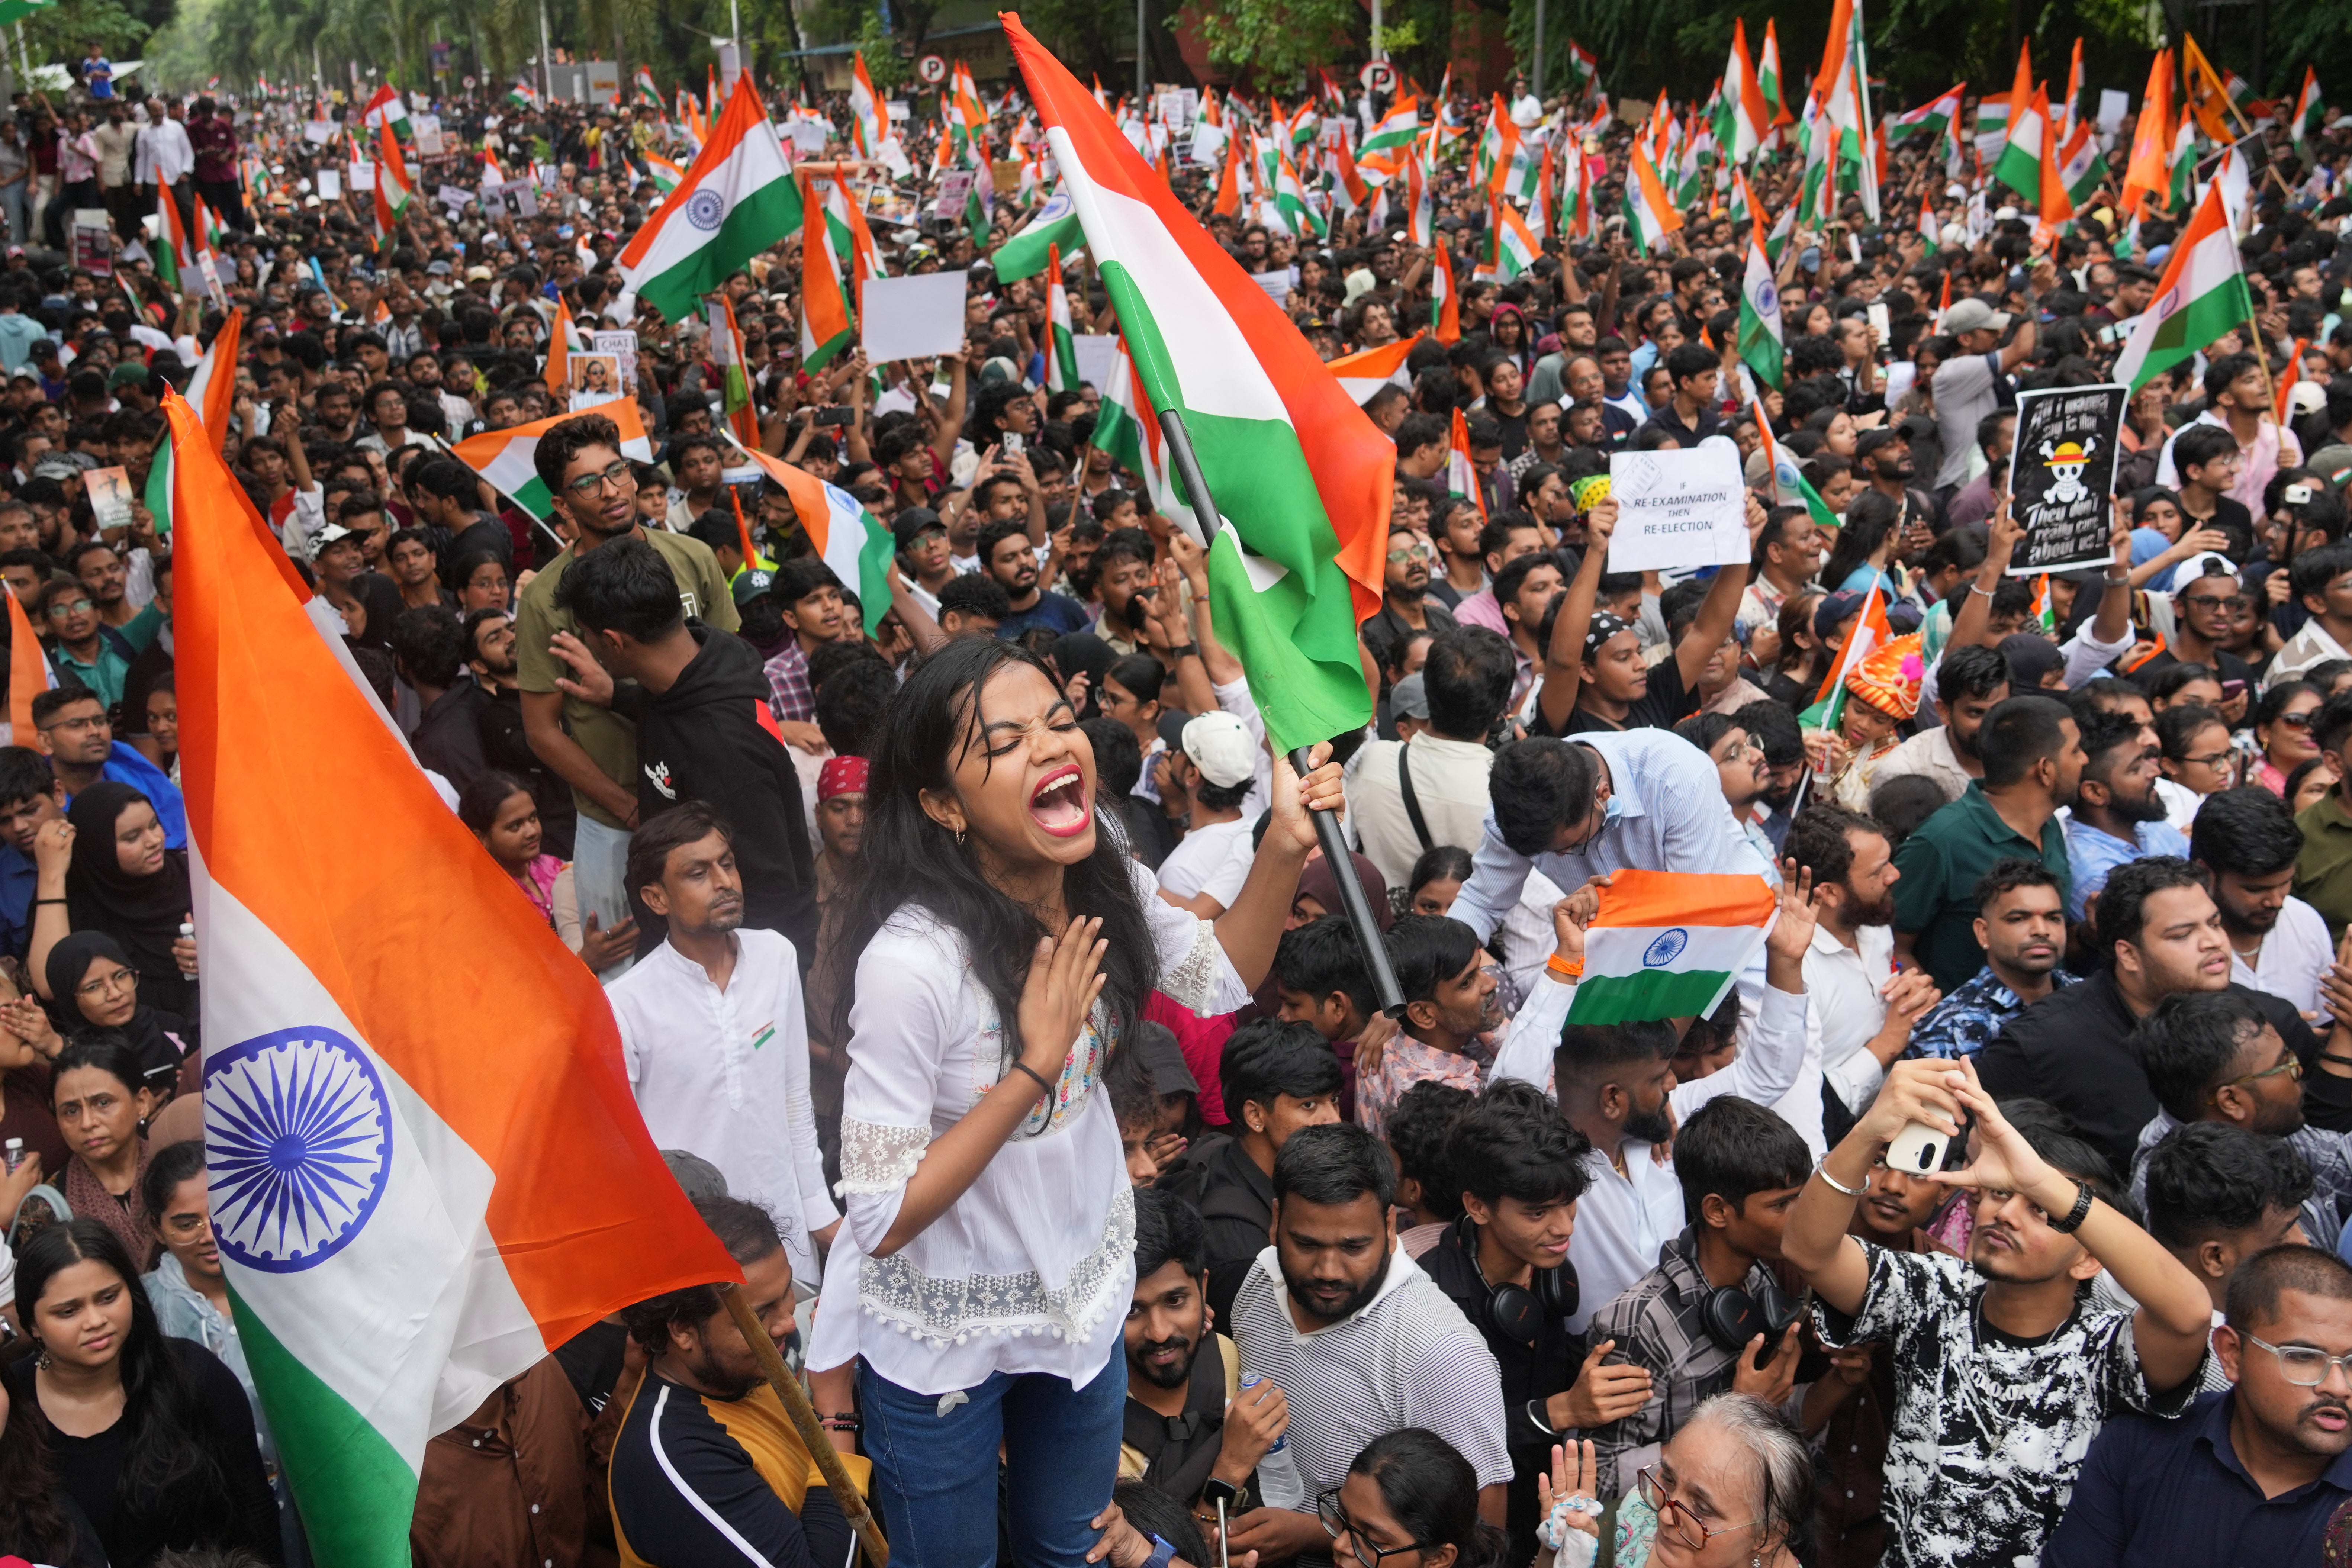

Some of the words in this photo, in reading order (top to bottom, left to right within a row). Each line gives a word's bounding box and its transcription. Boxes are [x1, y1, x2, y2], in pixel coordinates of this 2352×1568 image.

[929, 61, 939, 78] P
[1372, 69, 1389, 90] P
[602, 338, 628, 350] CHAI
[2041, 420, 2063, 440] say
[2066, 414, 2077, 432] is
[1680, 482, 1687, 490] IF
[1634, 492, 1727, 508] RE-EXAMINATION
[1668, 508, 1690, 518] THEN
[2024, 500, 2067, 532] They
[1644, 520, 1712, 535] RE-ELECTION
[2033, 522, 2074, 544] really
[2028, 538, 2076, 566] about
